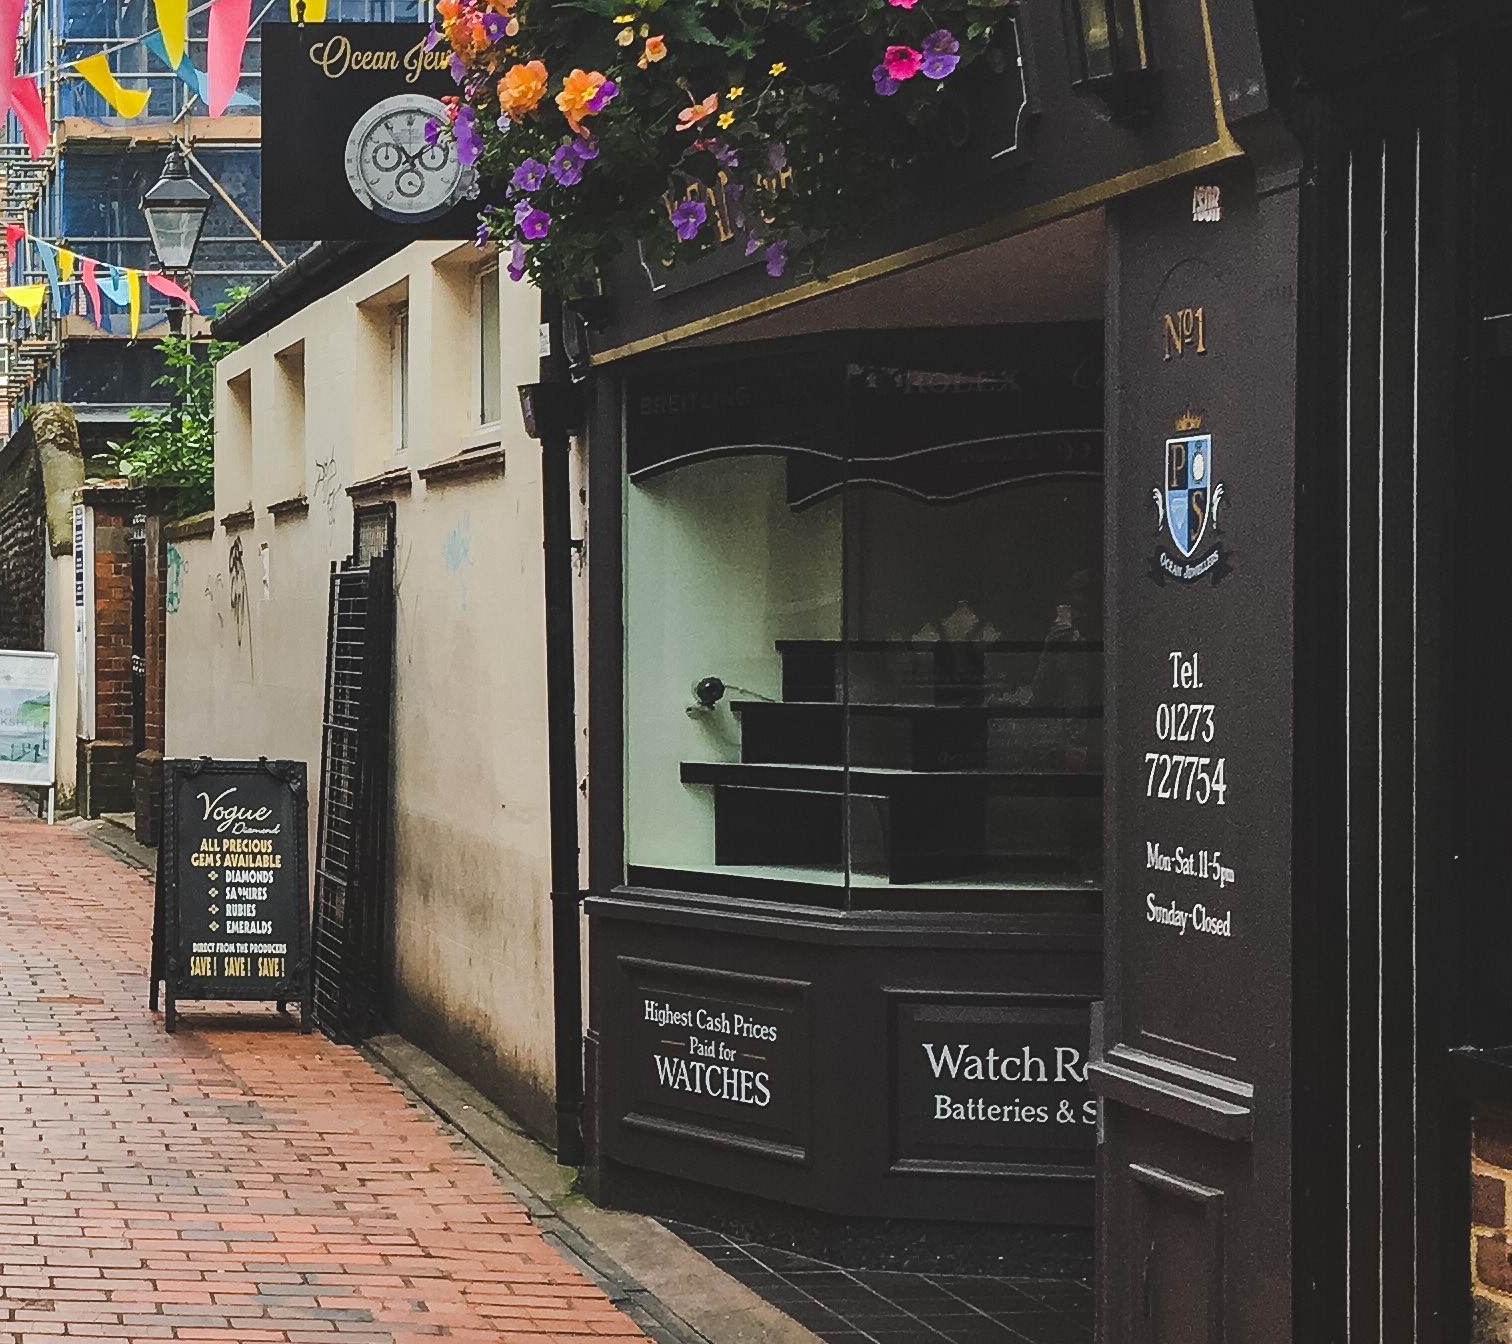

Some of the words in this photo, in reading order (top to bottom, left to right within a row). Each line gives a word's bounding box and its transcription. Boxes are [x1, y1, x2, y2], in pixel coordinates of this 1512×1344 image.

[309, 35, 399, 78] Ocean
[1169, 651, 1203, 689] Tel.
[1156, 703, 1215, 743] 01273
[1145, 752, 1227, 805] 727754
[196, 787, 273, 833] Vogue
[231, 821, 281, 835] Diamond
[191, 853, 221, 867] GEMS
[223, 854, 282, 868] AVAILABLE
[200, 838, 220, 852] ALL
[222, 839, 273, 853] PRECIOUS
[225, 870, 274, 884] DIAMONDS
[225, 903, 256, 917] RUBIES
[226, 920, 273, 934] EMERALDS
[192, 942, 215, 953] DIRECT
[216, 942, 235, 953] FROM
[236, 942, 248, 953] THE
[644, 999, 693, 1028] Highest
[695, 1009, 731, 1035] Cash
[734, 1017, 778, 1042] Prices
[689, 1036, 715, 1058] Paid
[717, 1042, 737, 1062] for
[922, 1043, 1048, 1083] Watch
[654, 1054, 771, 1107] WATCHES
[934, 1094, 1050, 1124] Batteries
[1056, 1099, 1076, 1124] &
